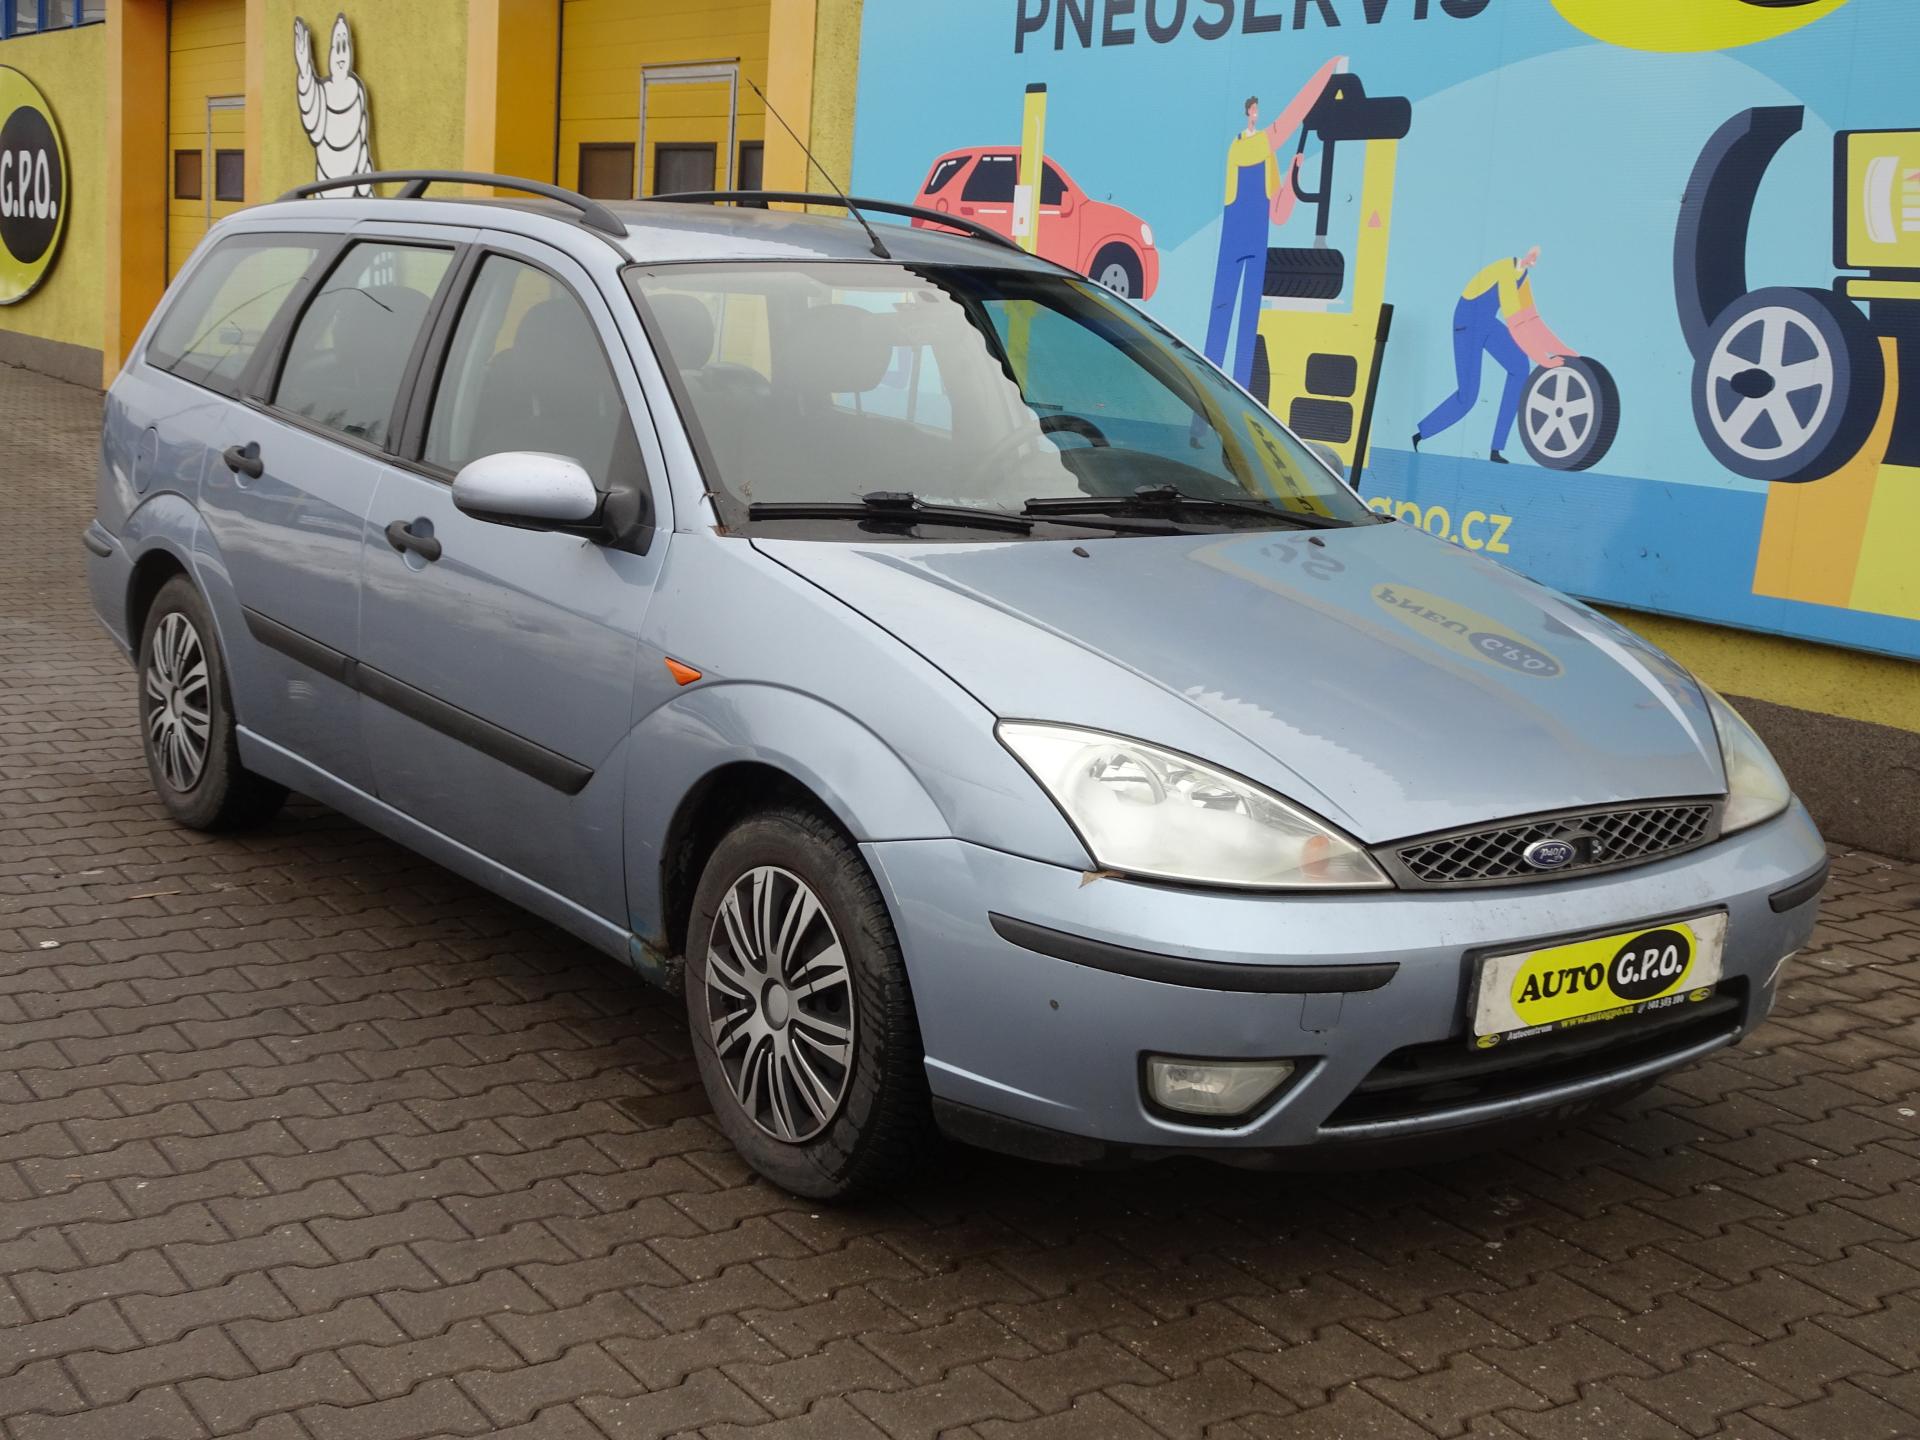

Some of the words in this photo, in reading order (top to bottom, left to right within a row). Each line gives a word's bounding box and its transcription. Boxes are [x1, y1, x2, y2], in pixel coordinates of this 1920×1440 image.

[0, 148, 57, 220] G.P.O.
[1517, 962, 1605, 1004] AUTO
[1616, 944, 1684, 985] G.P.O.
